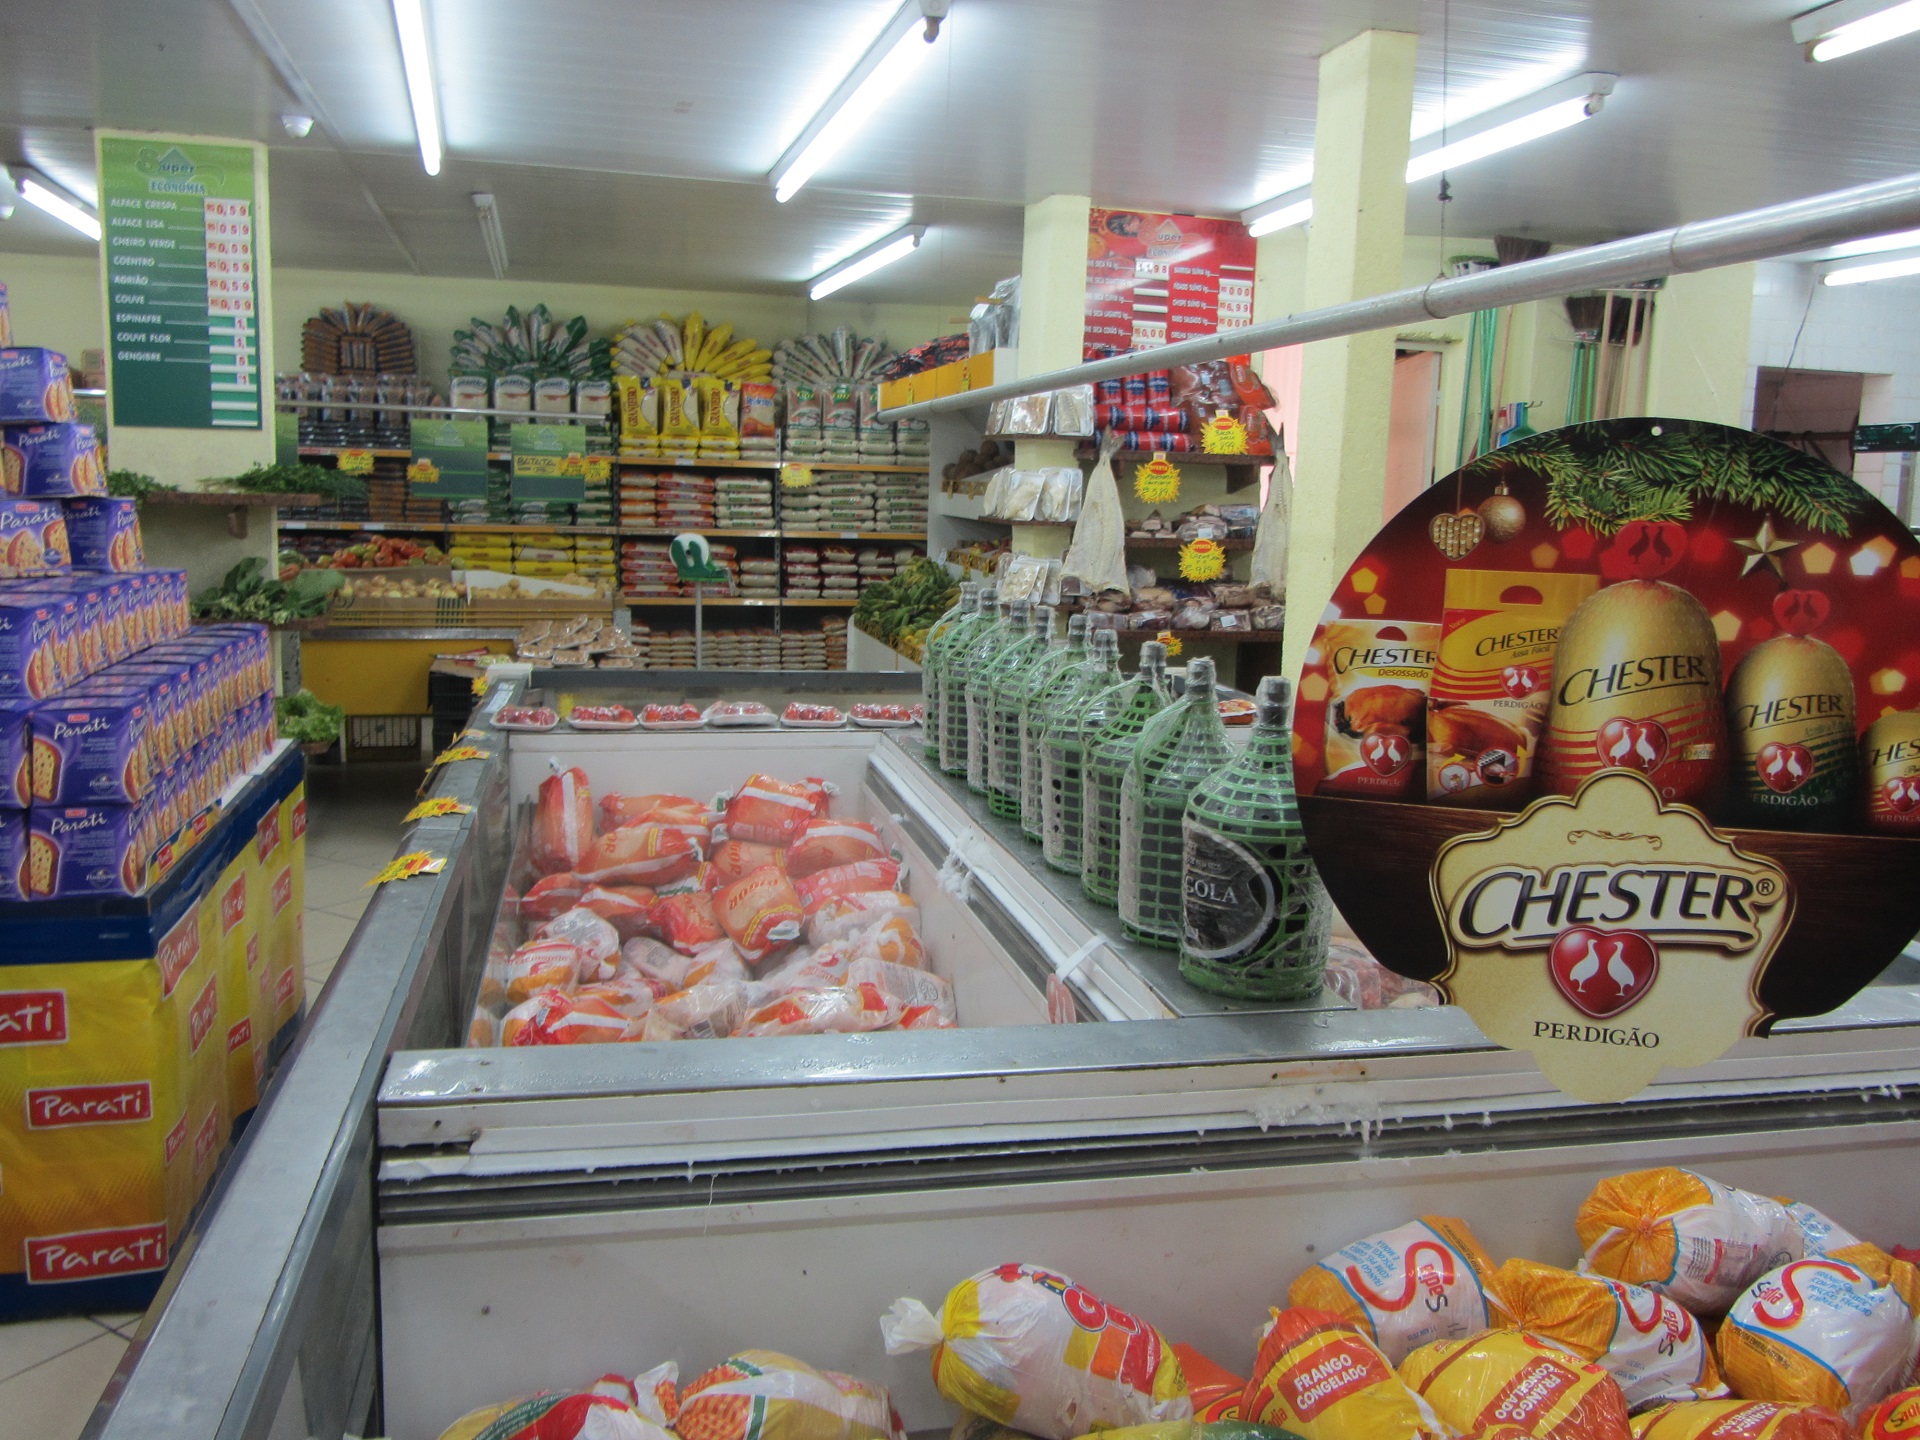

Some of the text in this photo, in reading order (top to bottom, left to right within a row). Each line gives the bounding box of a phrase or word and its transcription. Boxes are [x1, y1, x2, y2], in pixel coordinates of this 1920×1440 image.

[110, 198, 141, 209] ALFACE
[145, 200, 177, 211] CRESPA
[111, 217, 142, 228] ALFACE
[146, 219, 164, 229] LISA
[113, 237, 145, 247] CHEIRO
[149, 239, 175, 249] VERDE
[114, 256, 155, 266] COENTRO
[114, 274, 148, 285] AGRIÃO
[115, 295, 145, 304] COUVE
[116, 313, 162, 324] ESPINAFRE
[117, 332, 146, 342] COUVE
[150, 333, 172, 343] FLOR
[0, 354, 34, 370] arati
[118, 352, 161, 362] GENGIBRE
[19, 430, 61, 447] Parati
[1, 507, 60, 530] Parati
[1475, 628, 1558, 656] CHESTER
[1377, 668, 1429, 679] Desossado
[1558, 655, 1706, 707] CHESTER
[1493, 700, 1544, 710] PERDIGÃO
[1736, 694, 1844, 733] CHESTER
[54, 716, 111, 740] Parati
[51, 812, 107, 834] Parati
[1533, 1020, 1660, 1049] PERDIGÃO
[36, 1090, 142, 1120] Parati
[36, 1234, 163, 1273] Parati
[1294, 1353, 1352, 1392] FRANGO
[1296, 1364, 1367, 1410] CONGELADO
[1495, 1363, 1556, 1419] CONGELADO
[1512, 1373, 1562, 1420] FRANGO
